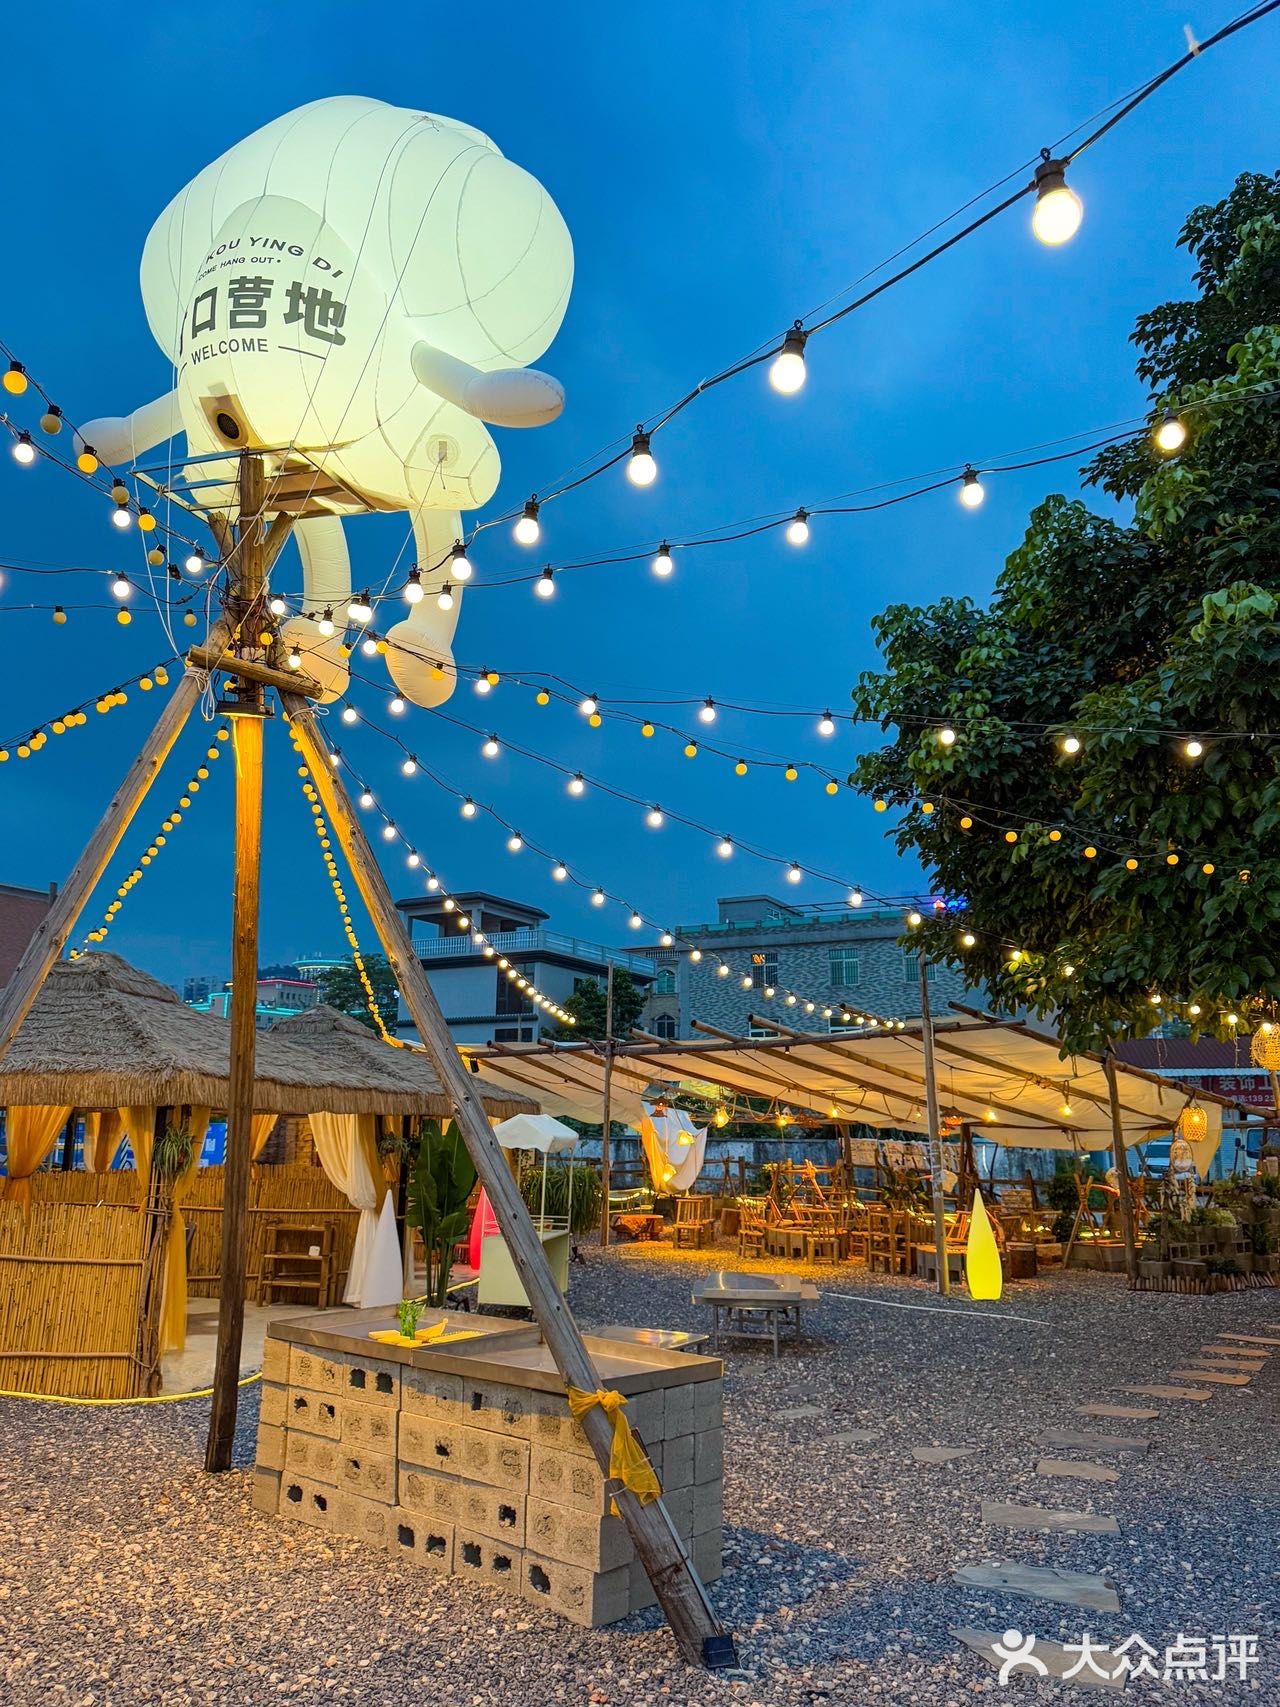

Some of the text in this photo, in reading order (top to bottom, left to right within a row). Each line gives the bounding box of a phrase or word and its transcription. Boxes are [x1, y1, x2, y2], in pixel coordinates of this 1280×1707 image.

[206, 236, 343, 279] KOU YING DI
[219, 256, 246, 269] HANG
[179, 275, 347, 347] 口营地
[191, 338, 269, 366] WELCOME
